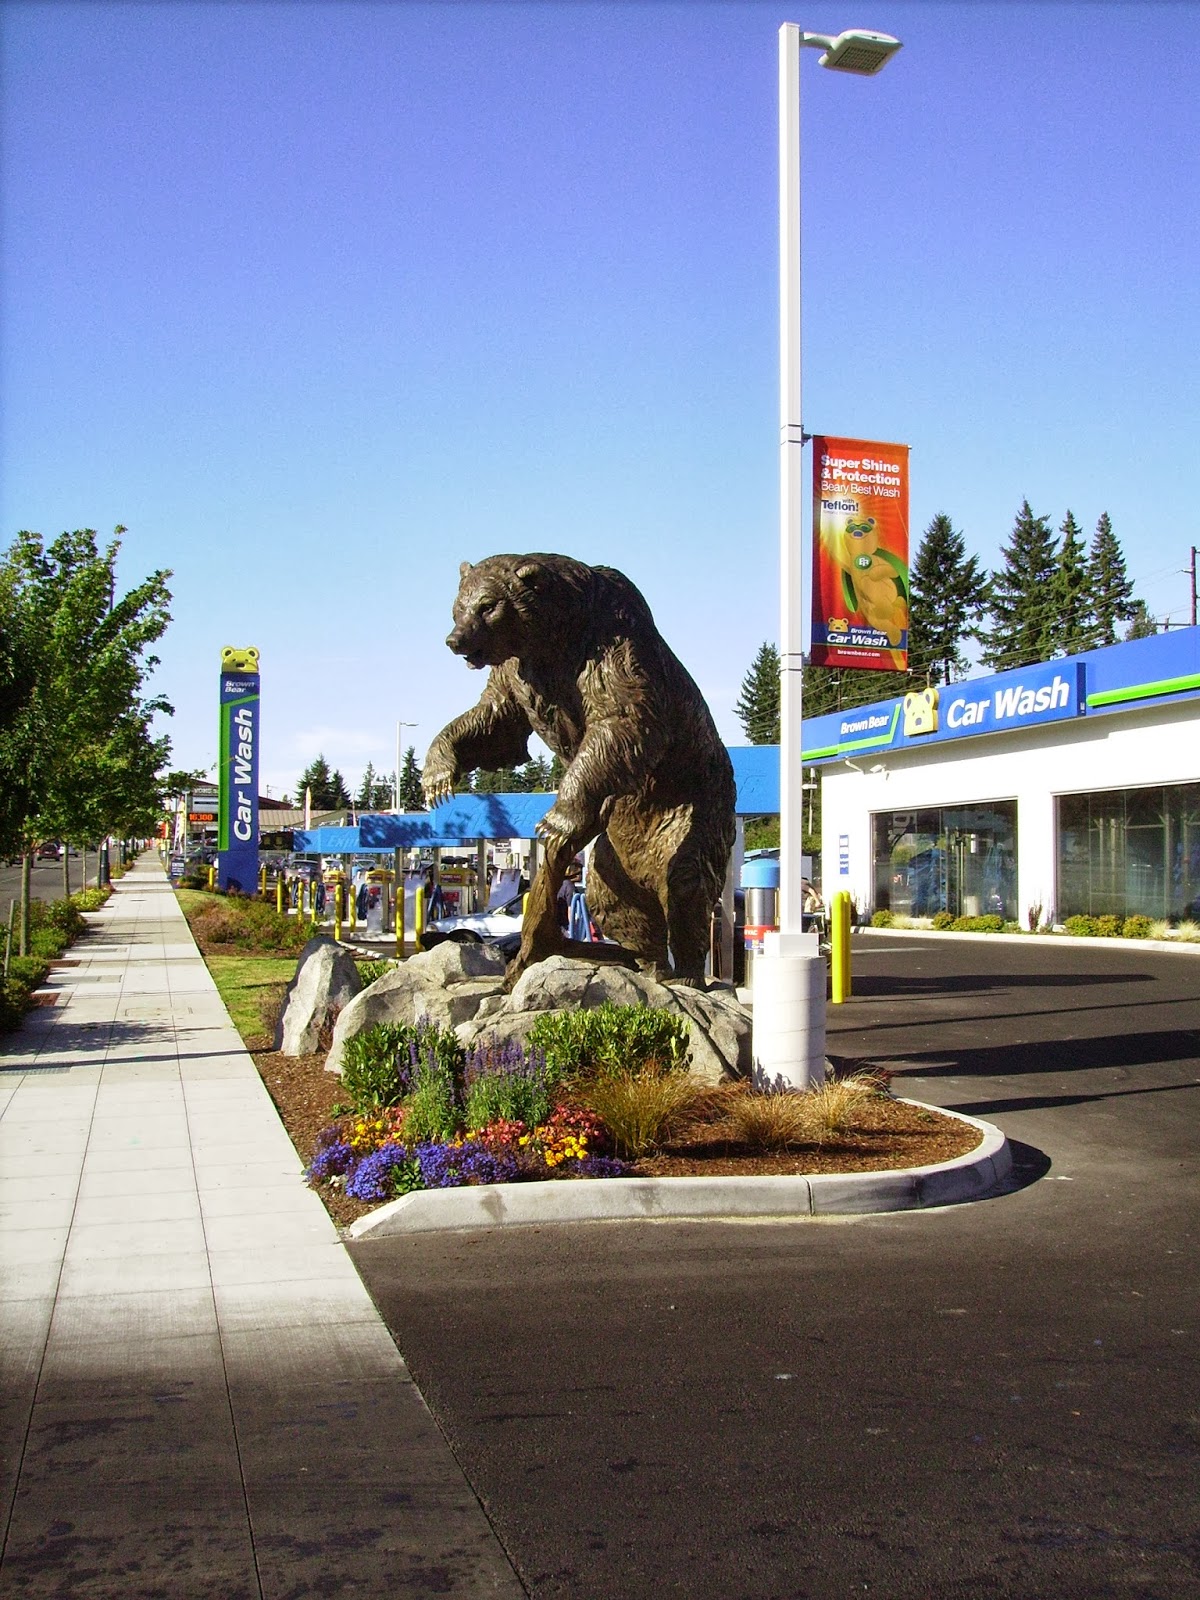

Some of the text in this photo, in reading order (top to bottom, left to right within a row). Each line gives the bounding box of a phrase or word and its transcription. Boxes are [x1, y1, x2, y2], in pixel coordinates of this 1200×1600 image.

[821, 455, 900, 473] Super Shine
[821, 468, 900, 485] & Protection
[821, 481, 900, 498] Beary Best Wash
[821, 500, 859, 511] Teflon!
[826, 633, 888, 647] Car Wash
[837, 649, 881, 657] brownbear.com
[840, 715, 869, 735] Brown
[869, 713, 889, 730] Bear
[947, 698, 990, 729] Car
[994, 675, 1070, 719] Wash
[233, 708, 253, 841] Car Wash
